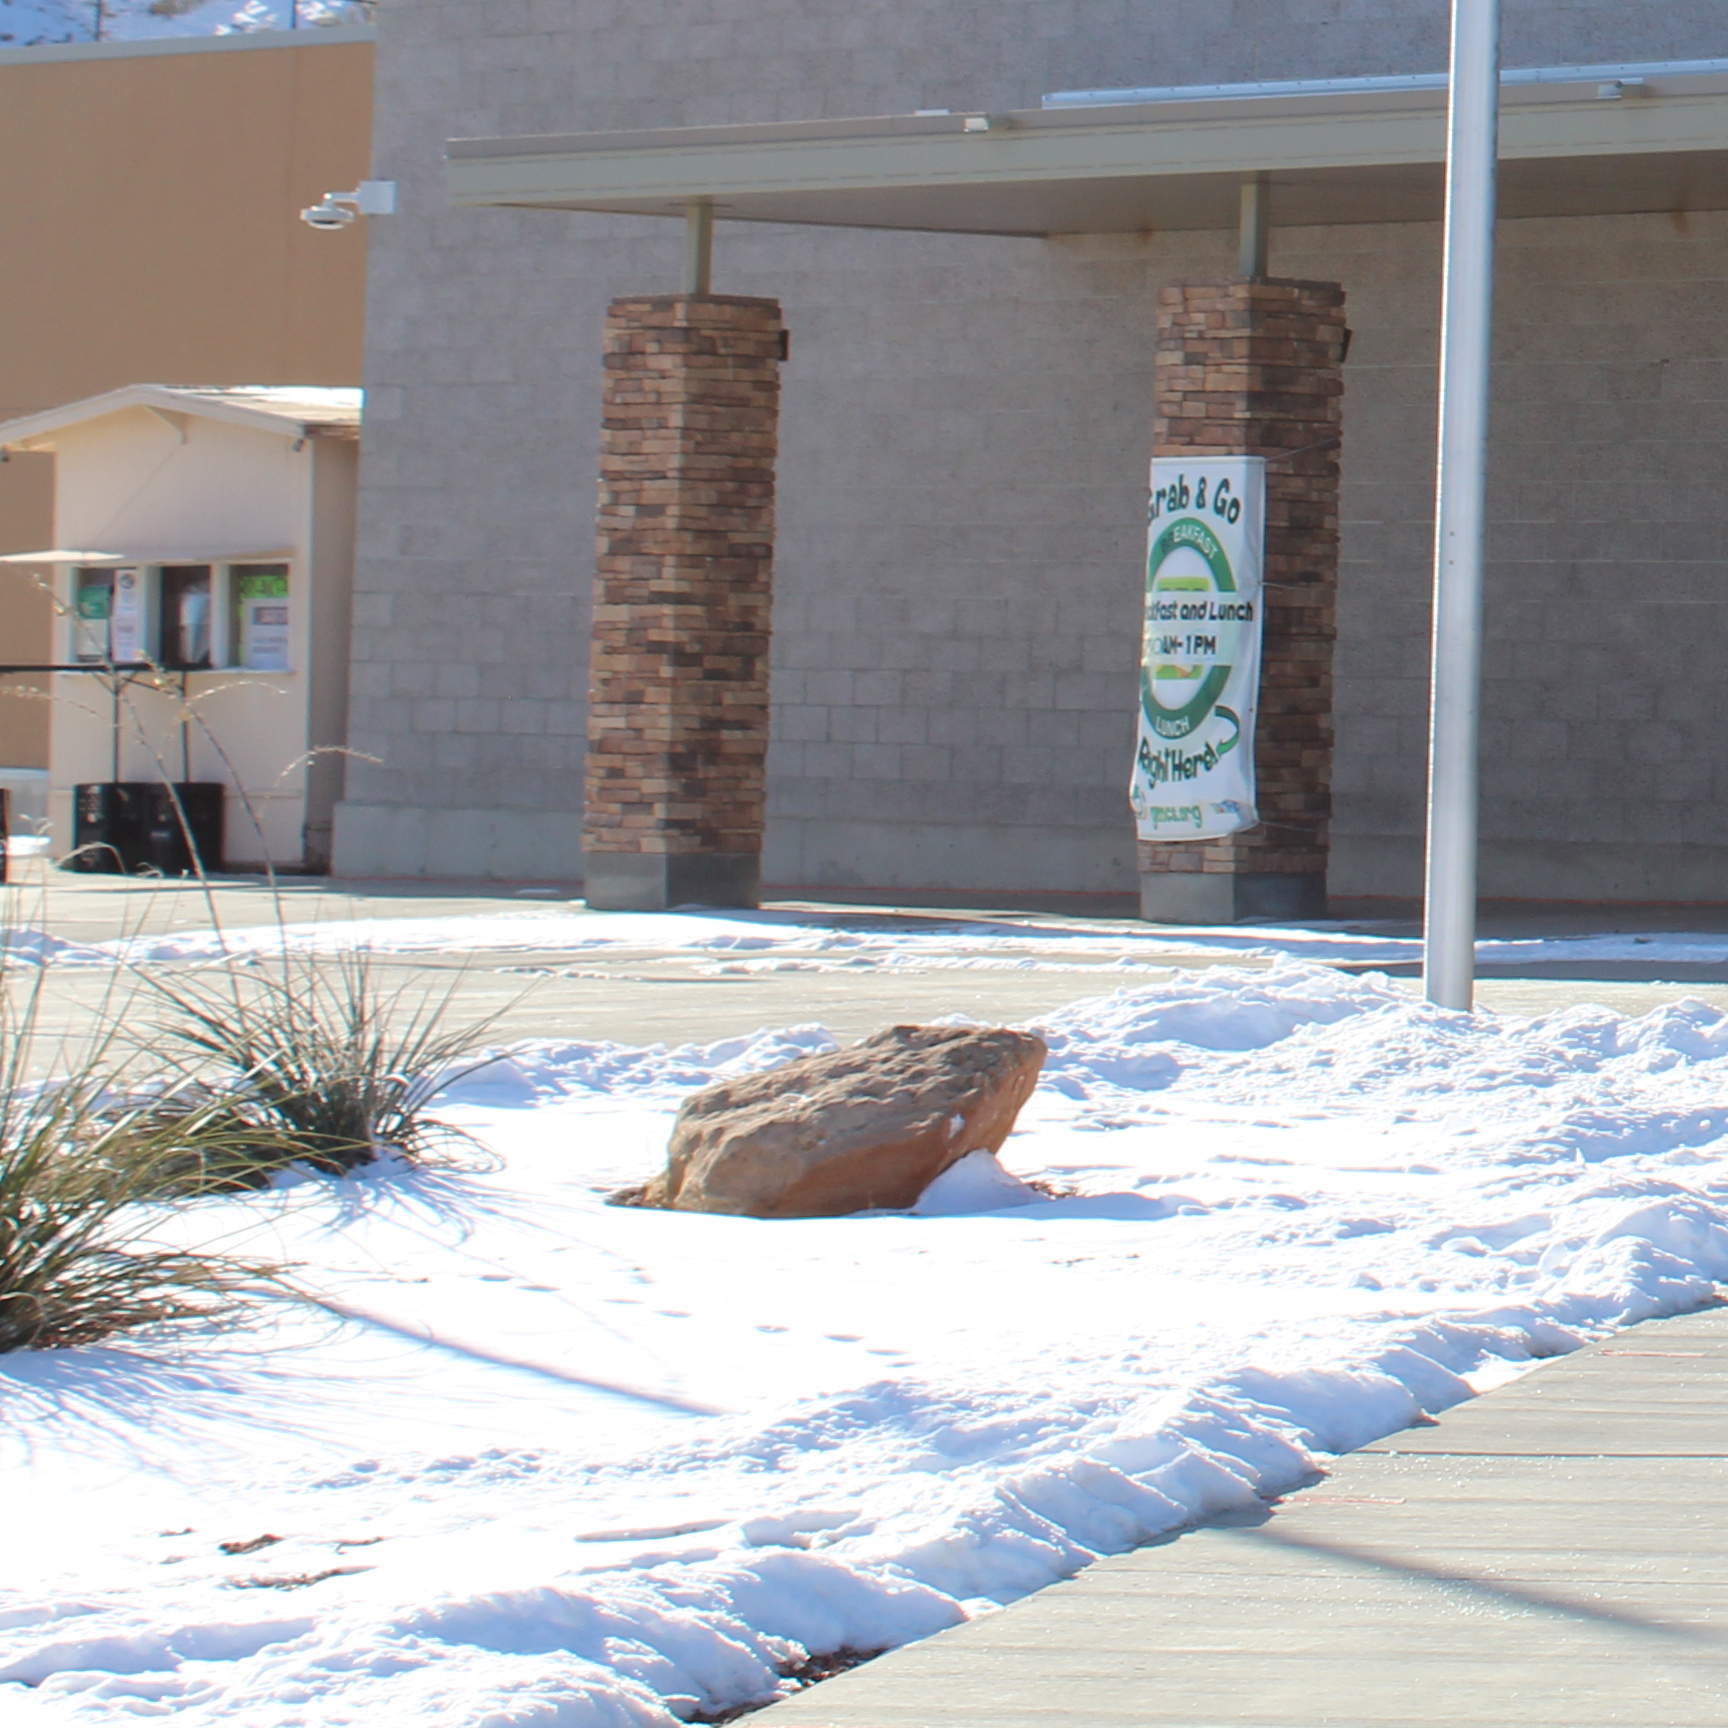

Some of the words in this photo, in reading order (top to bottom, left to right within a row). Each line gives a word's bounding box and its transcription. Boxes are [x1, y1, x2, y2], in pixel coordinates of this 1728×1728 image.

[1213, 478, 1240, 525] Go
[1180, 600, 1207, 621] and
[1208, 601, 1254, 621] Lunch
[1155, 715, 1191, 736] LUNCH
